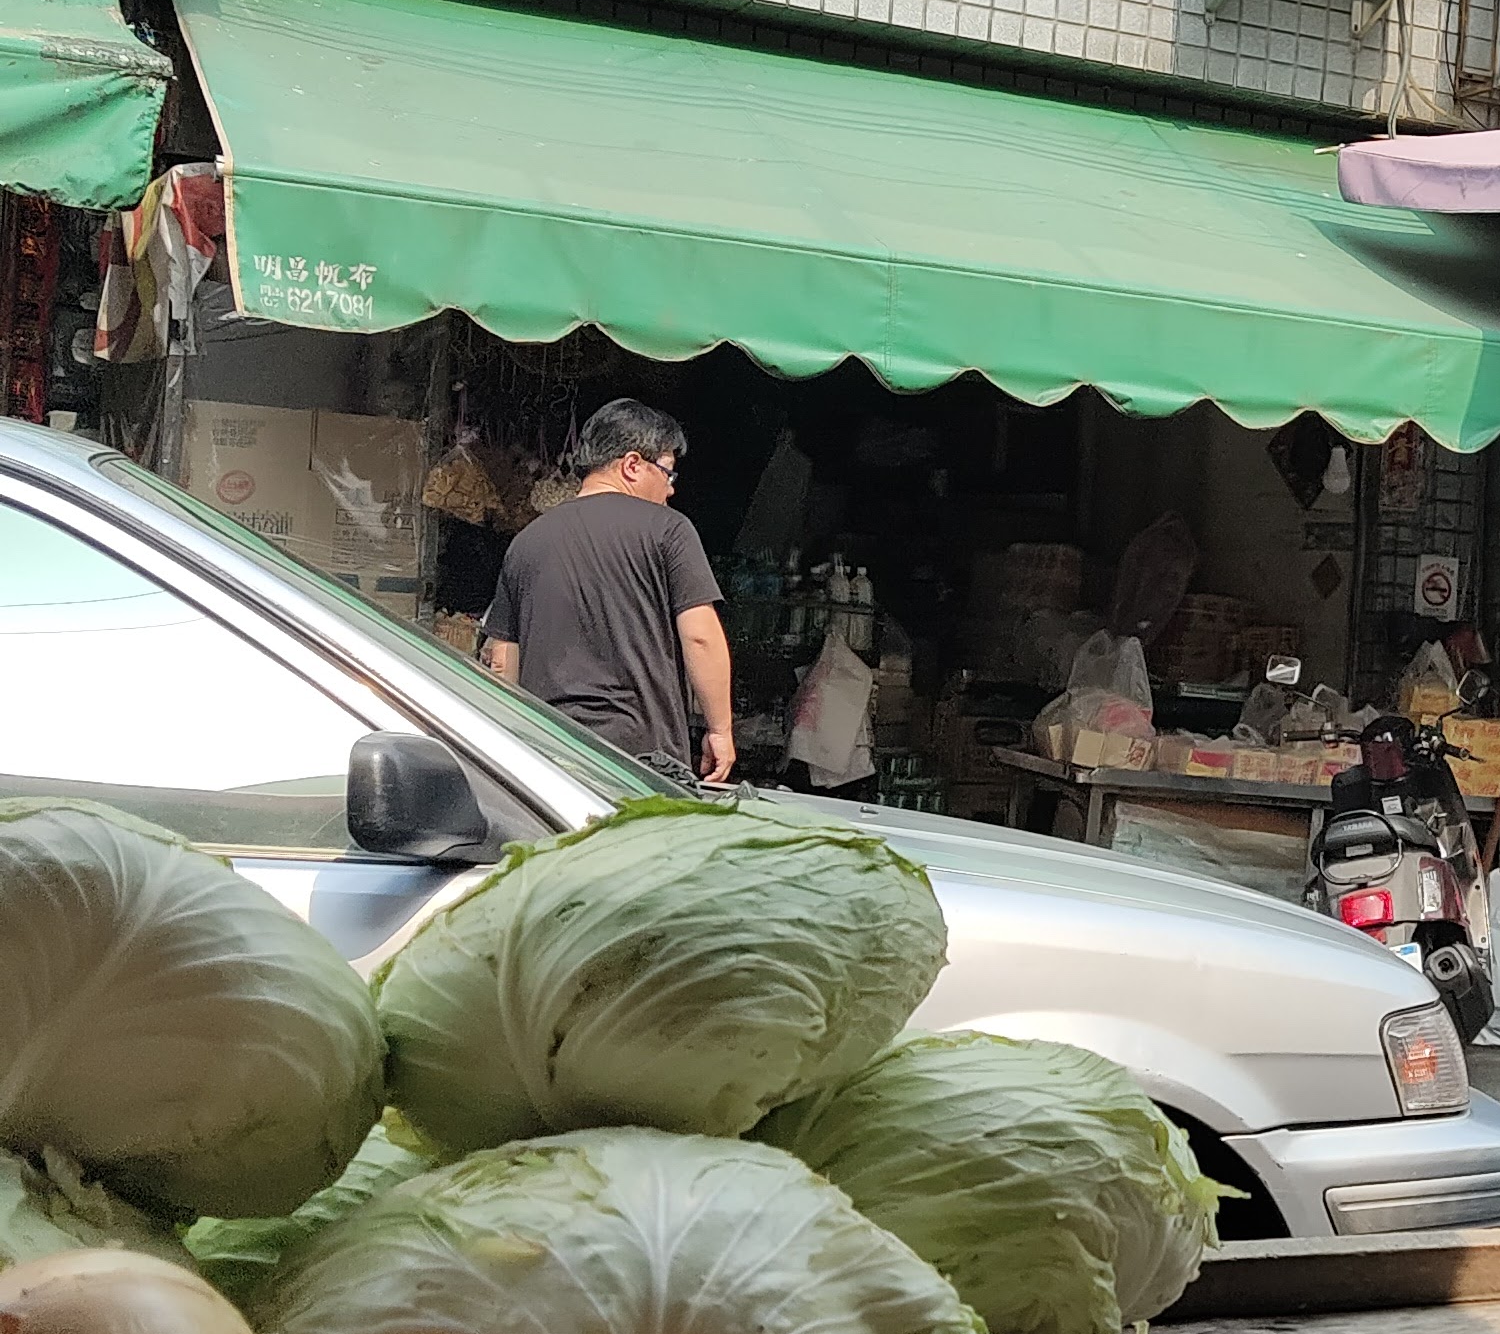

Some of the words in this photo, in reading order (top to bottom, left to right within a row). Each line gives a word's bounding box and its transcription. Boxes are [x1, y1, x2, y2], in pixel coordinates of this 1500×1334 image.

[253, 254, 378, 292] 明昌帆布
[287, 286, 374, 320] 6217081
